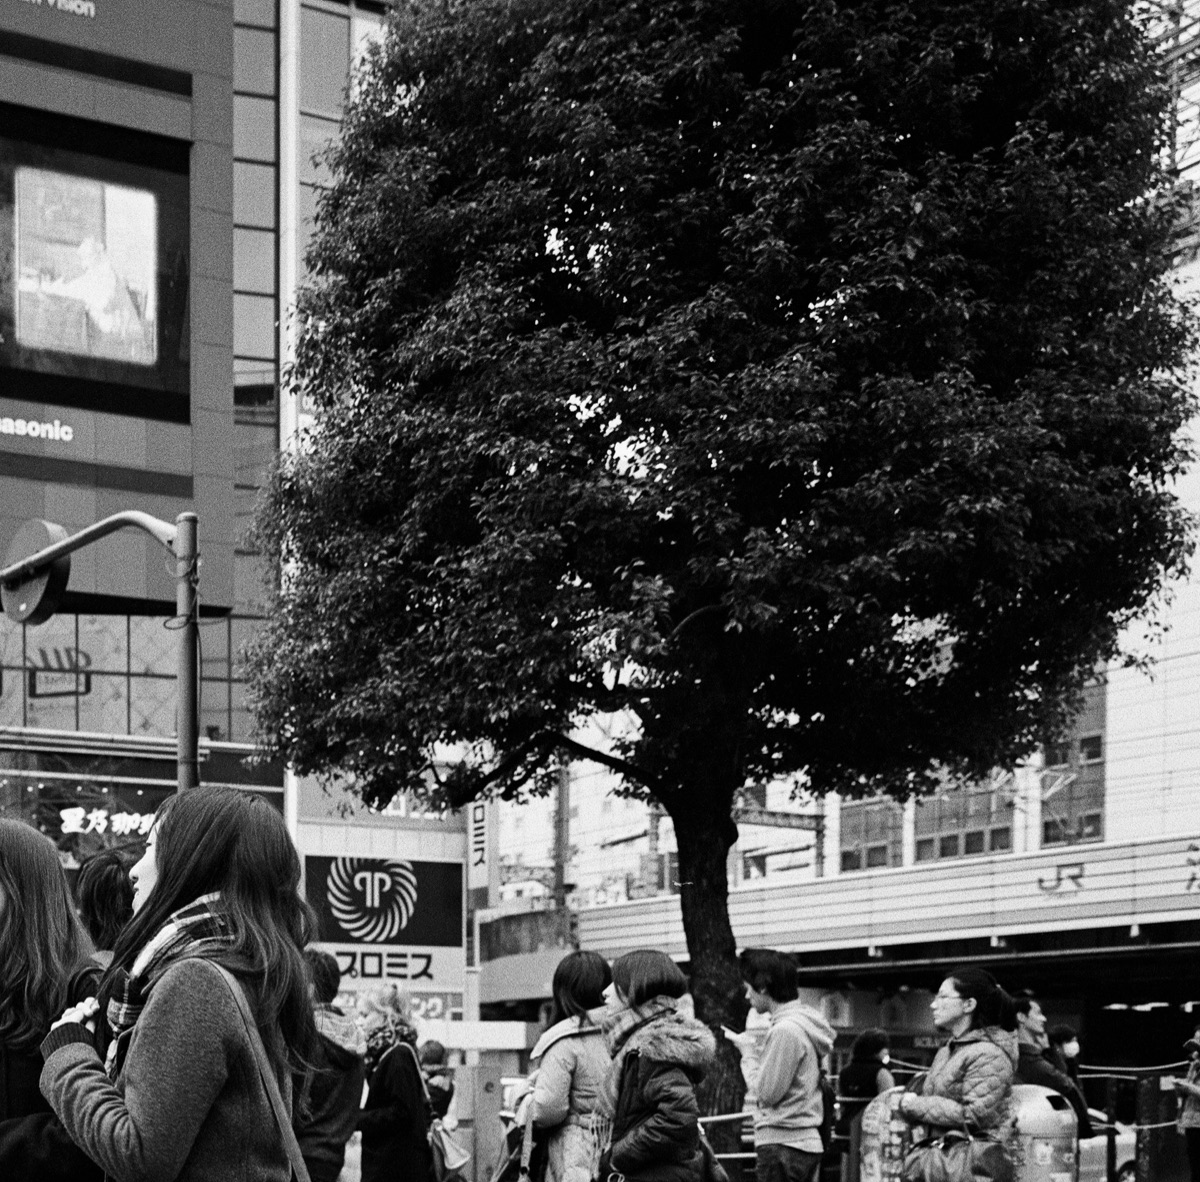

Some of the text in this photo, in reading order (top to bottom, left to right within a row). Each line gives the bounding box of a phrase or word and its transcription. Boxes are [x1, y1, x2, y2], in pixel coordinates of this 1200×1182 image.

[473, 804, 486, 867] ロミス
[1038, 862, 1085, 890] JR
[335, 951, 434, 980] プロミス
